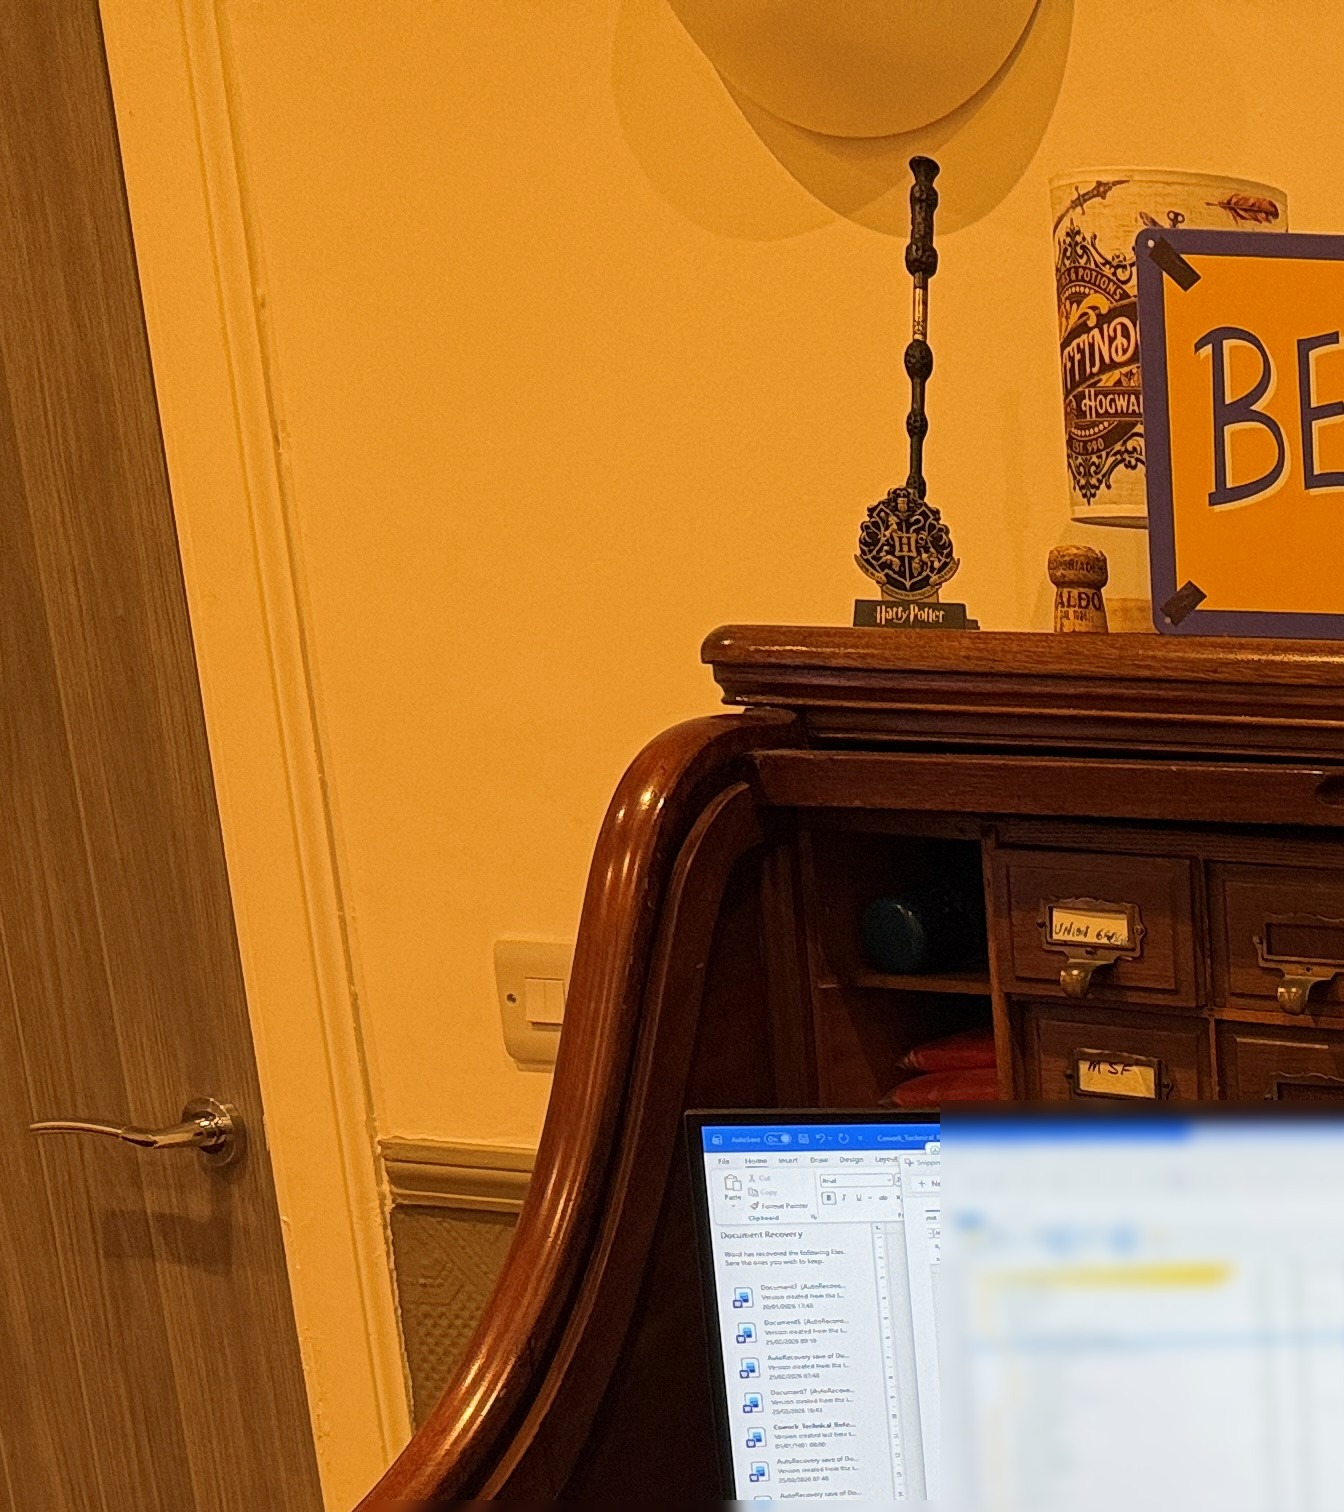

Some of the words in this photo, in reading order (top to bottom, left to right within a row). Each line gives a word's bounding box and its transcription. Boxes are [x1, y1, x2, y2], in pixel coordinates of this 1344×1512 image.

[1078, 267, 1123, 300] POTIONS
[1062, 316, 1140, 391] FFIND
[876, 605, 909, 624] Harry
[910, 604, 944, 625] Potter
